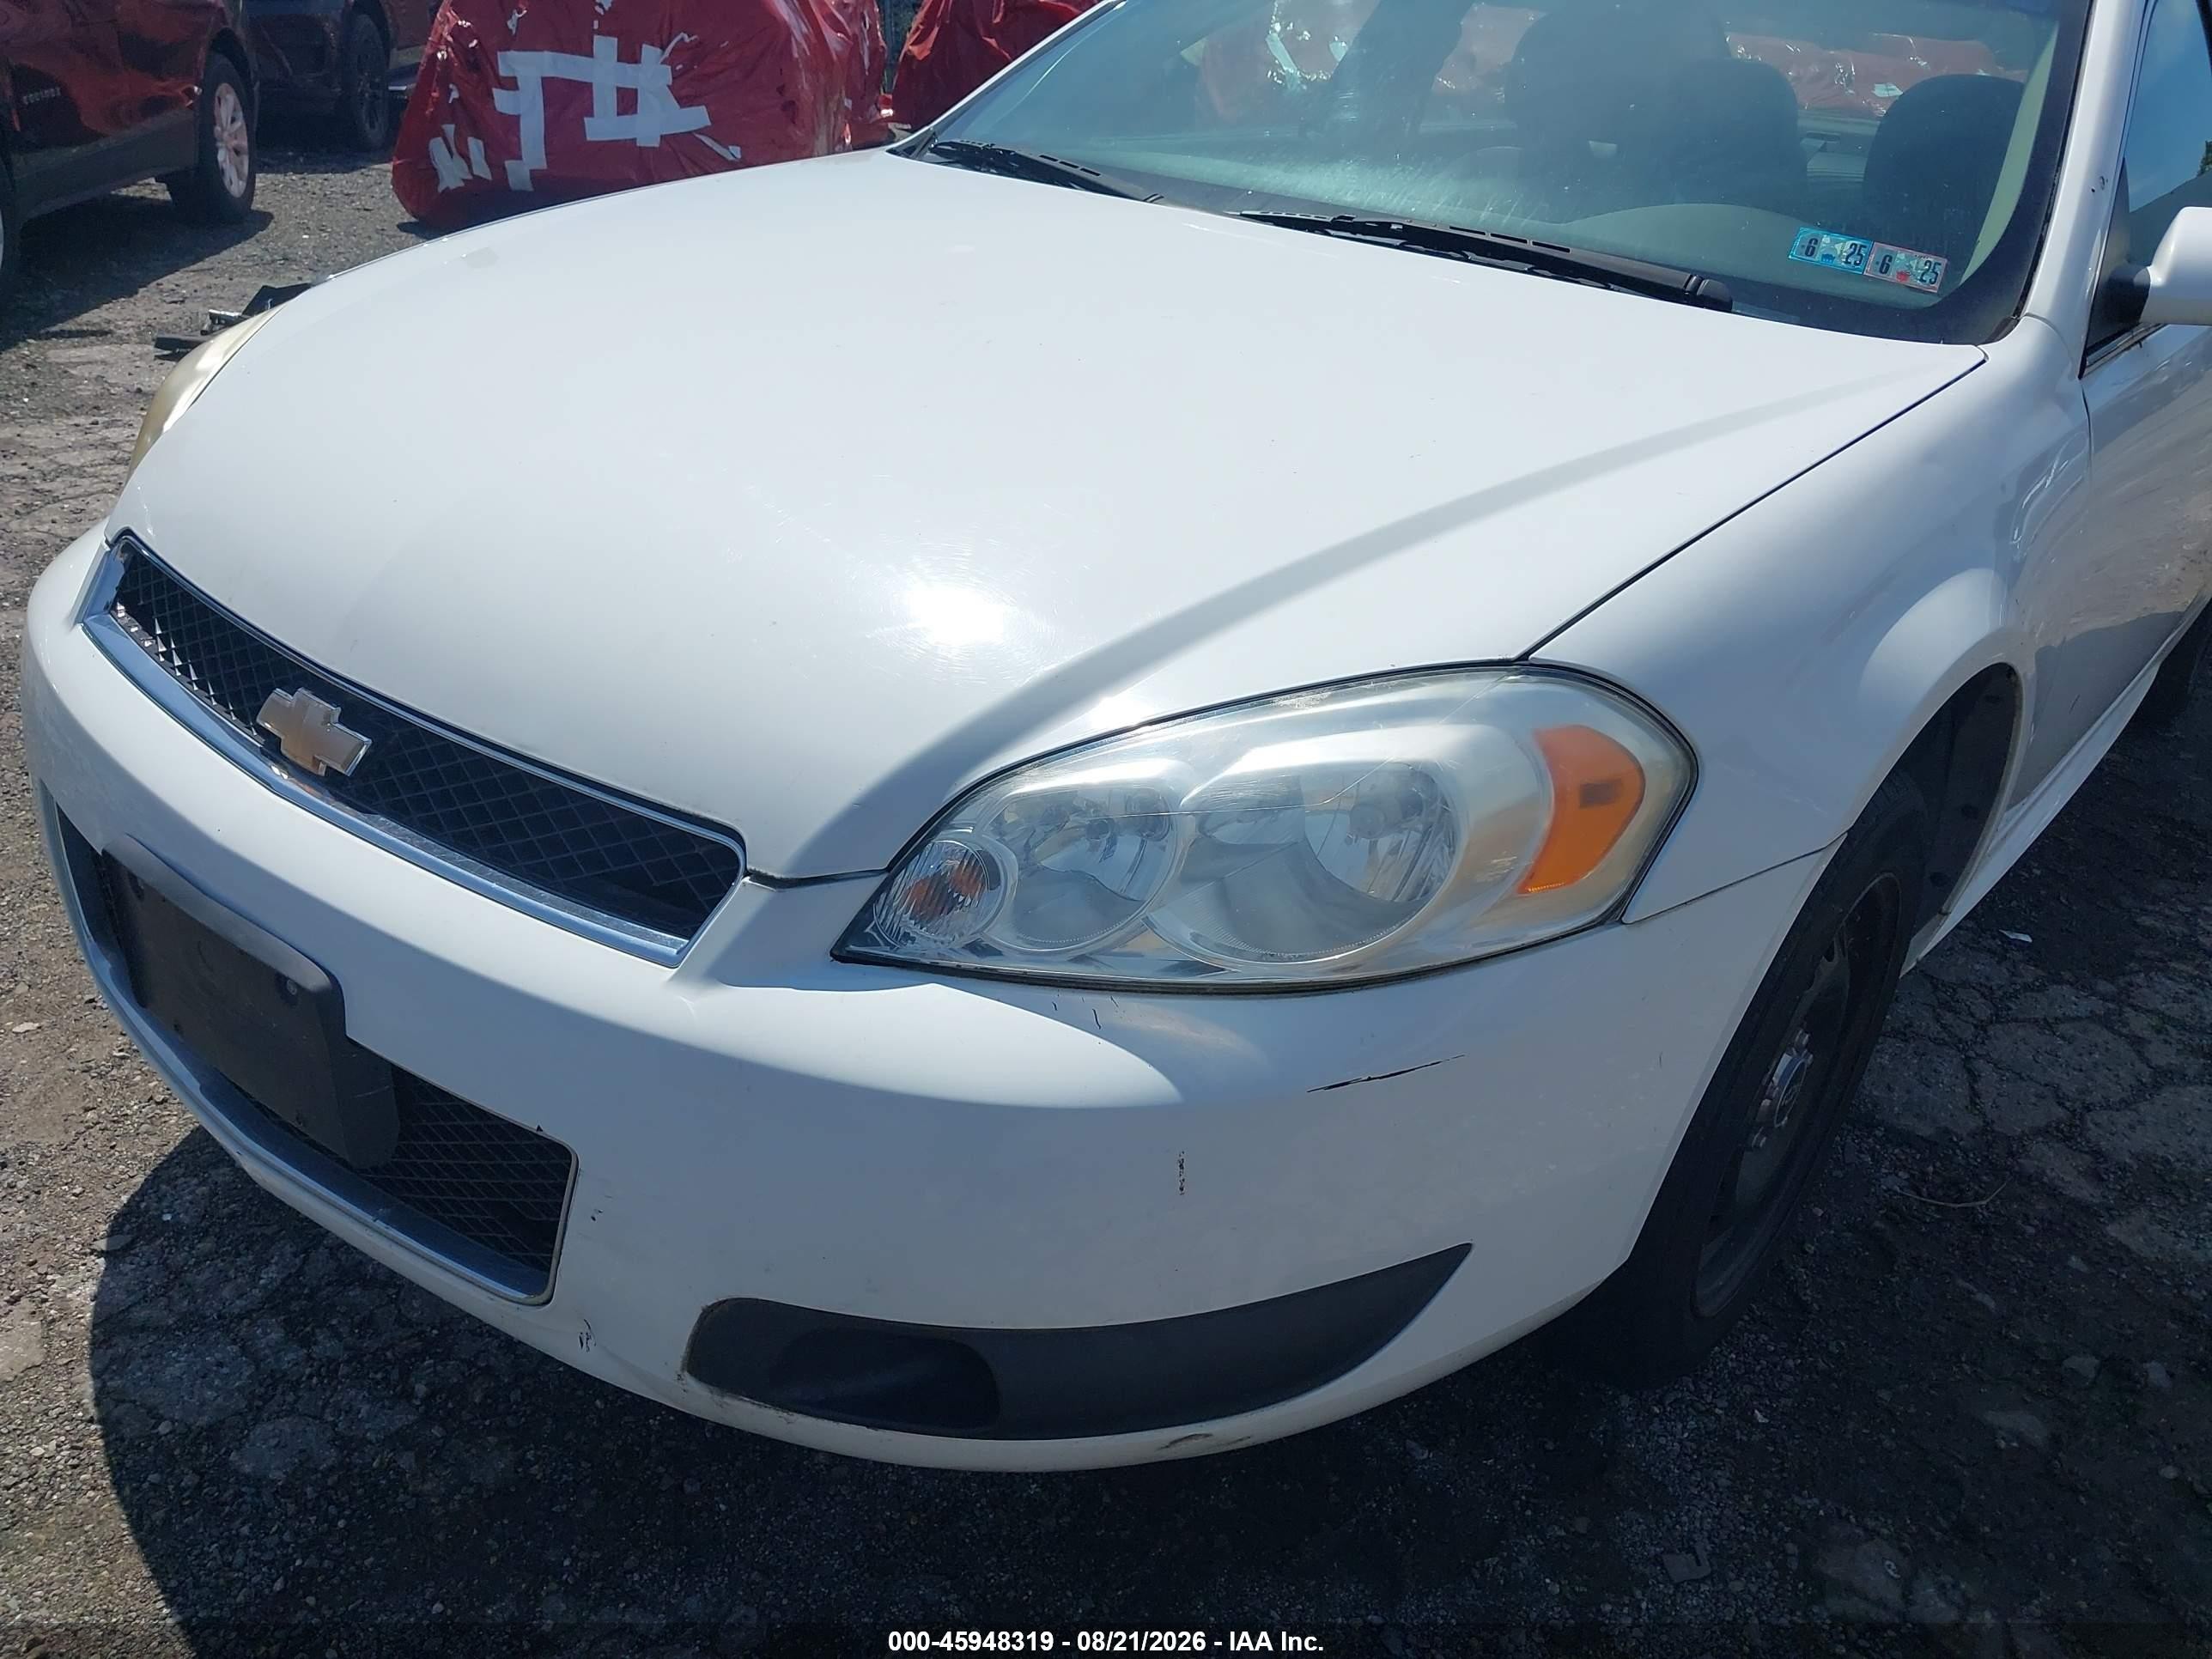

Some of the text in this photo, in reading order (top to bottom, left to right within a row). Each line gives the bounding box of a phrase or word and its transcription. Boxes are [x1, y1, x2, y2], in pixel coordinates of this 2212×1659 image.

[1805, 238, 1818, 257] 6
[1844, 243, 1867, 266] 25
[1879, 254, 1942, 284] 6 25
